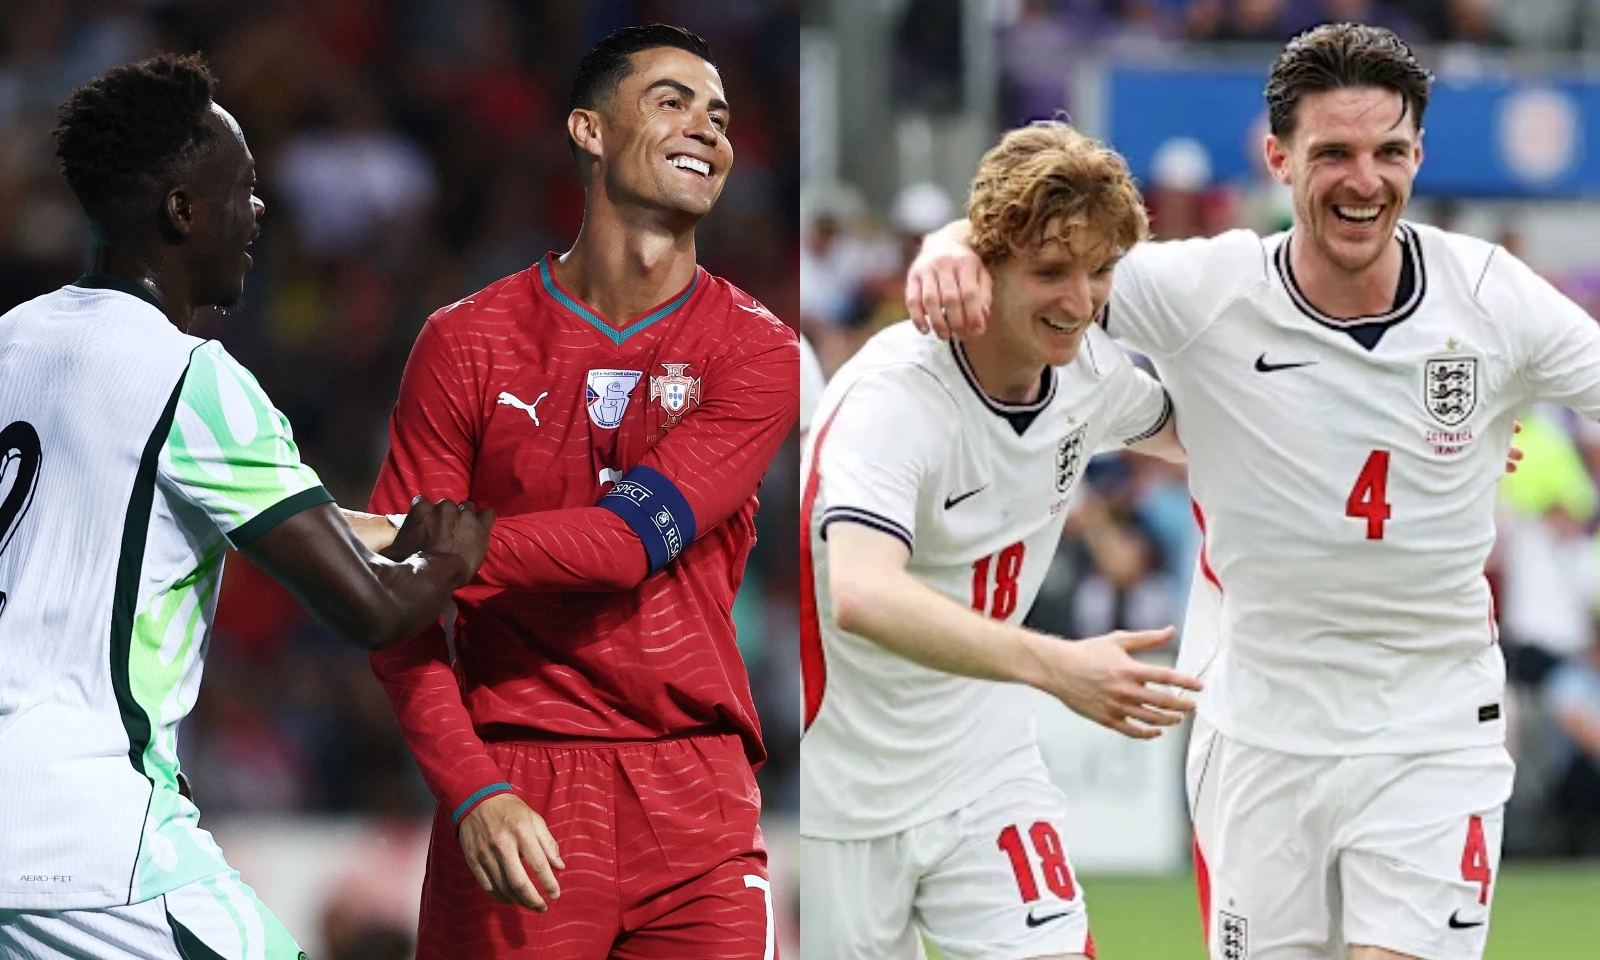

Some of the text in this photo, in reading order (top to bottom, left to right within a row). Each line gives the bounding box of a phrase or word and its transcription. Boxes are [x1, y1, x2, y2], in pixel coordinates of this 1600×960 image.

[1345, 450, 1391, 540] 4
[970, 540, 1026, 622] 18
[20, 874, 73, 883] AERO-FIT
[996, 821, 1076, 903] 18
[1461, 814, 1491, 906] 4
[743, 874, 775, 960] 7
